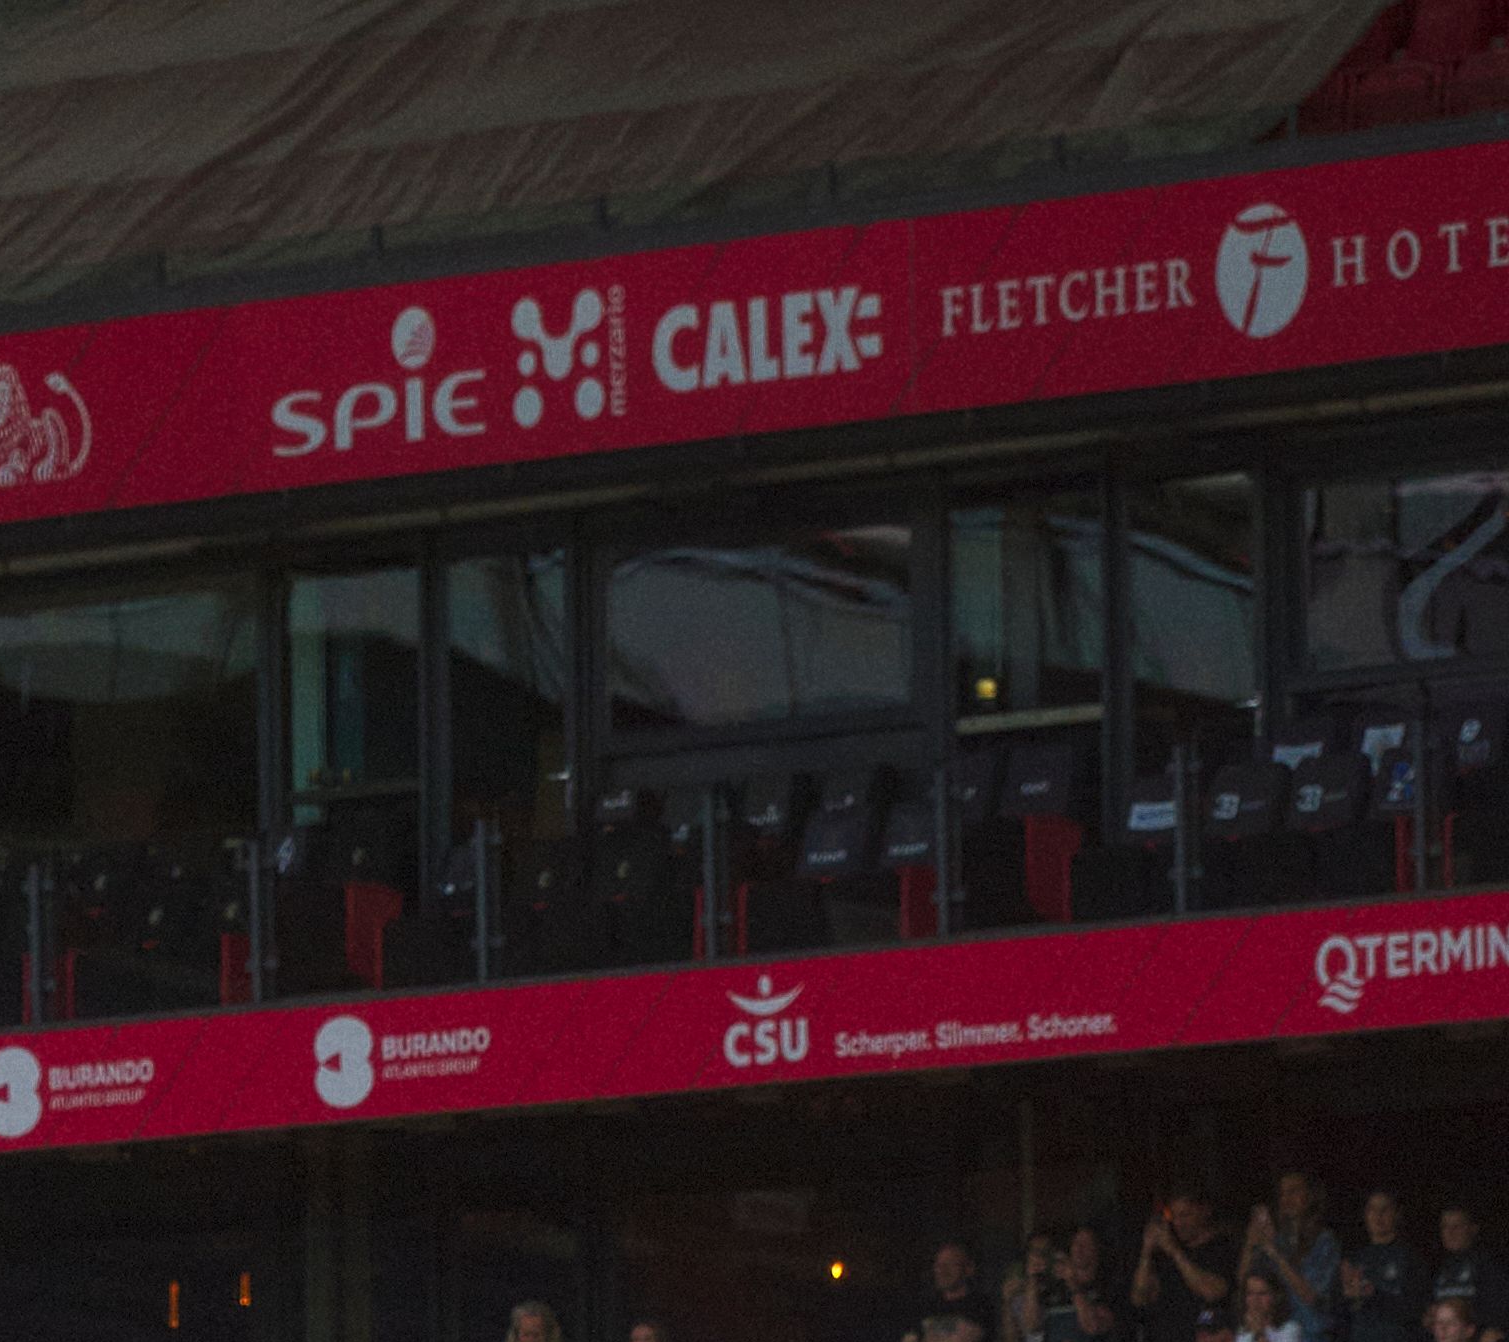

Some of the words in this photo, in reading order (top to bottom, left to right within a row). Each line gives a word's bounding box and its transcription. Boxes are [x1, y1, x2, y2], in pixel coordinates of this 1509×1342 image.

[940, 257, 1195, 338] FLETCHER
[271, 370, 487, 457] SPIE
[380, 1026, 491, 1061] BURANDO
[723, 1018, 810, 1068] CSU
[834, 1030, 932, 1058] Scherper.
[934, 1021, 1024, 1049] Slimmer.
[1026, 1013, 1118, 1041] Schoner.
[48, 1058, 155, 1090] BURANDO
